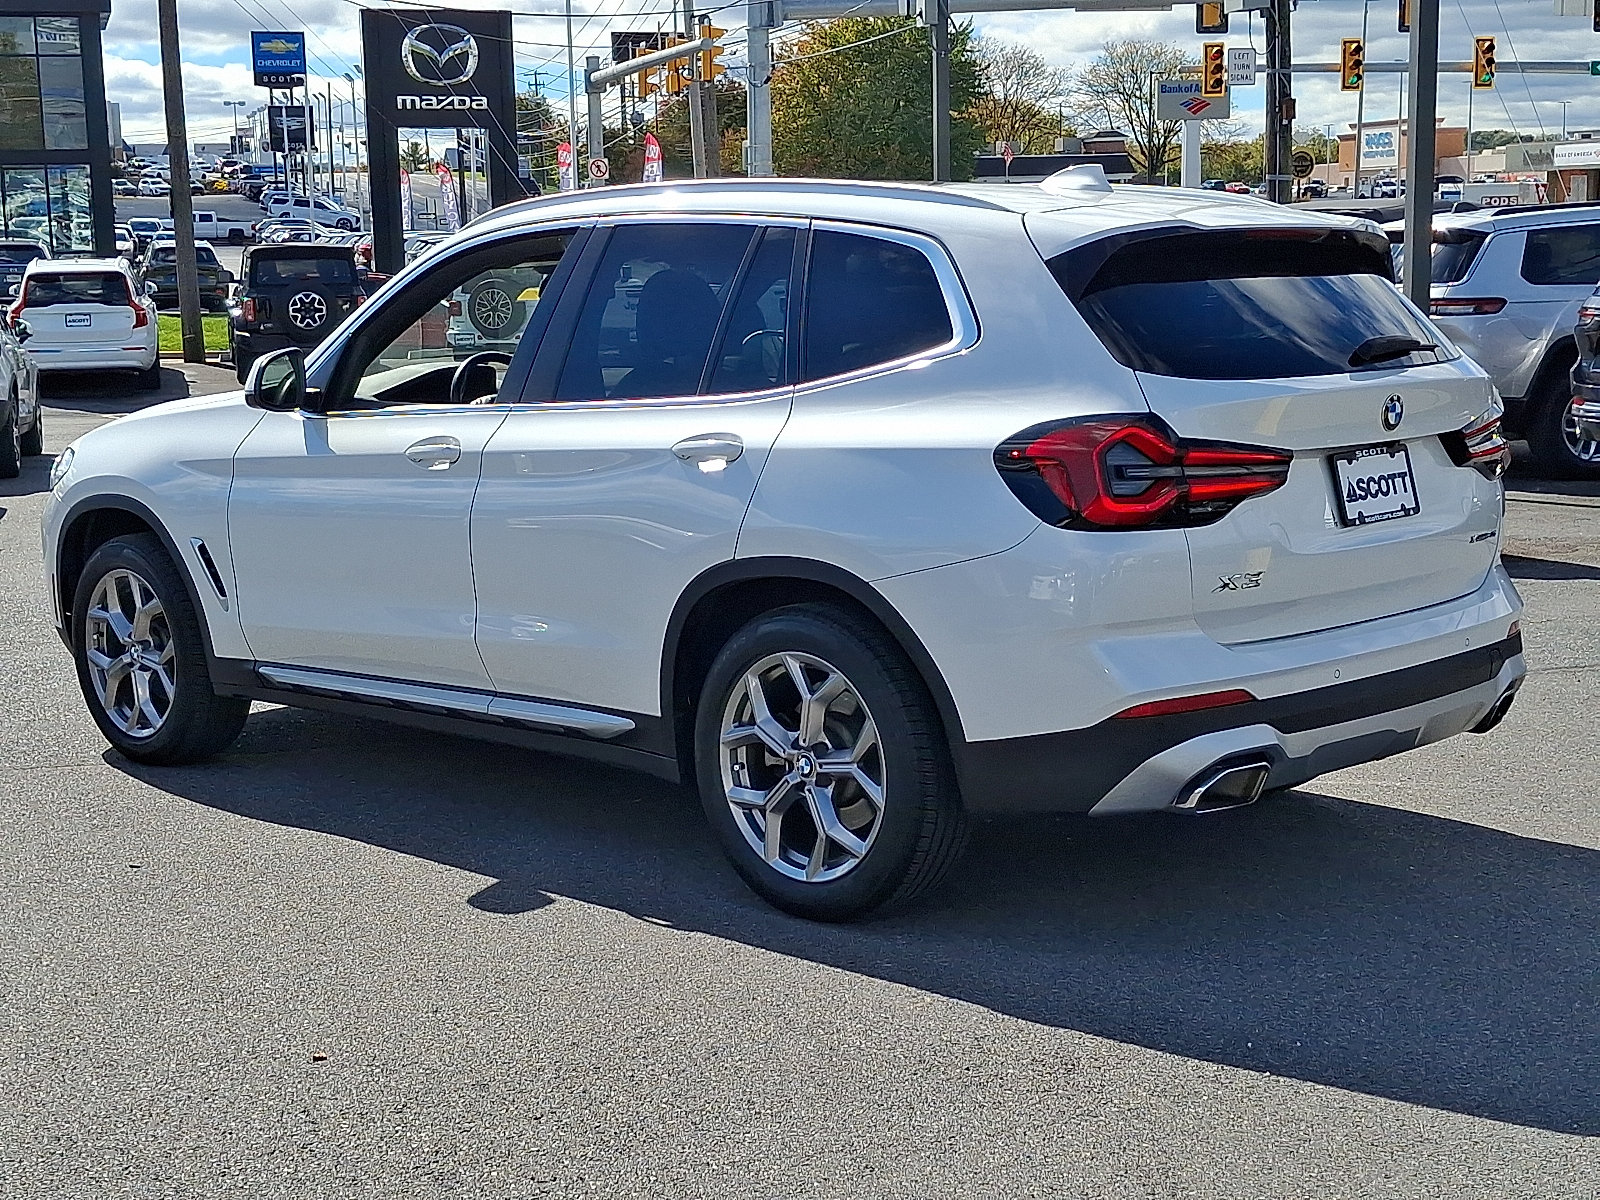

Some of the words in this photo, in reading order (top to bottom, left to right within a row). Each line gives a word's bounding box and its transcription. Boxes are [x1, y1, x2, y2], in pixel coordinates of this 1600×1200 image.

[1233, 52, 1249, 60] LEFT
[257, 59, 301, 67] CHEVROLET
[1233, 63, 1251, 71] TURN
[262, 75, 298, 83] SCOTT
[1230, 73, 1252, 82] SIGNAL
[1160, 83, 1183, 93] Bank
[1183, 83, 1194, 93] of
[1481, 197, 1518, 206] PODS
[1355, 447, 1388, 458] SCOTT
[1211, 571, 1265, 593] X3
